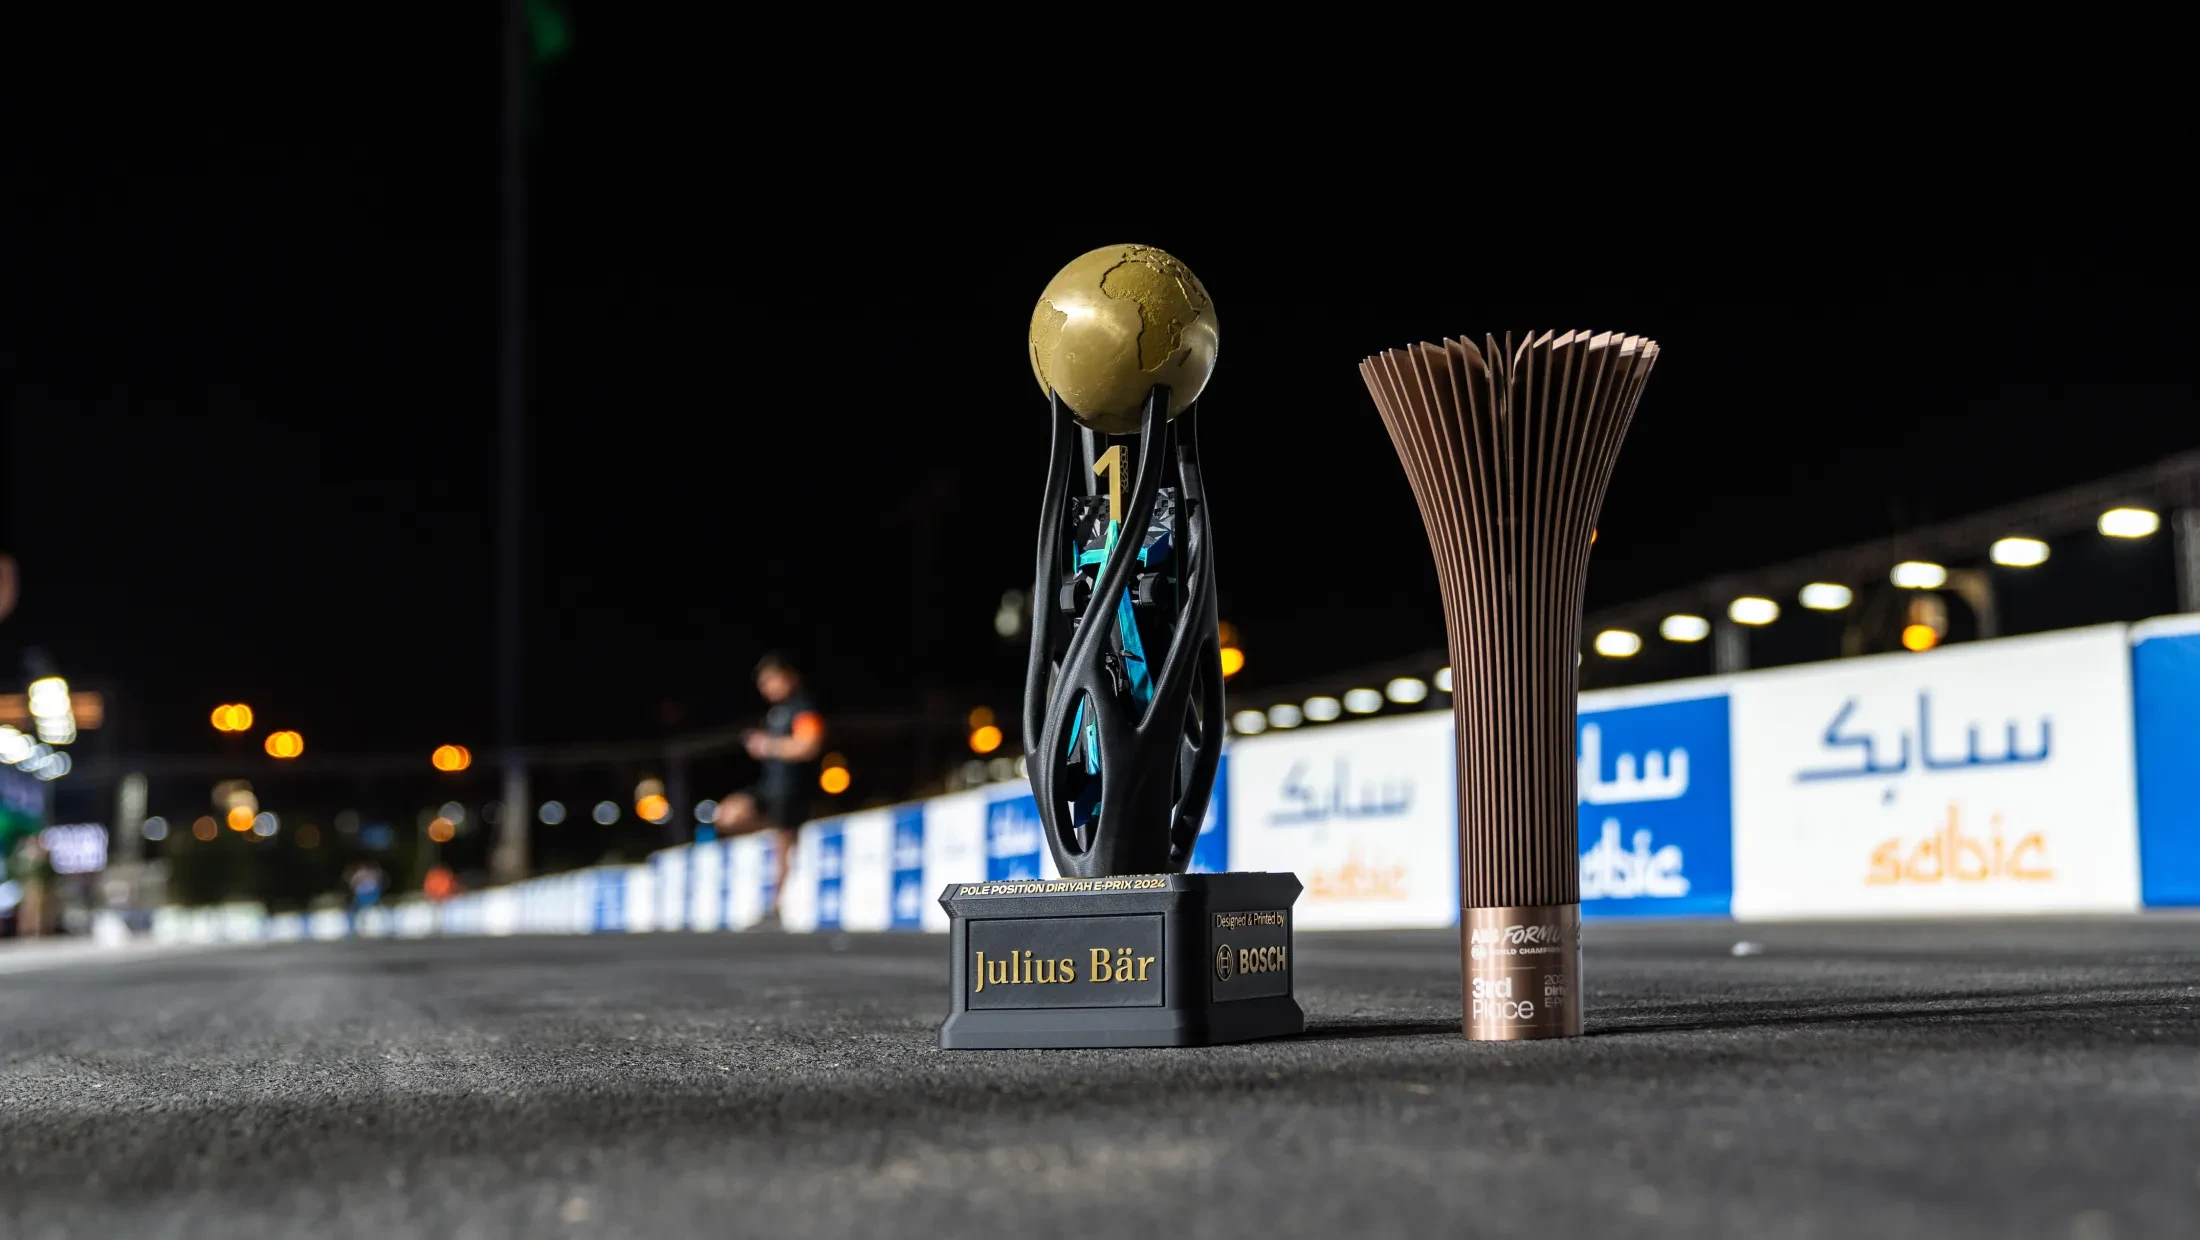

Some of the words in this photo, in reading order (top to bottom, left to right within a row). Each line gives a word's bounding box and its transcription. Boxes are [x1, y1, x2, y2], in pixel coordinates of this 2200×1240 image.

[1865, 801, 2053, 885] sabic
[960, 885, 991, 896] POLE
[991, 883, 1046, 894] POSITION
[1046, 881, 1092, 892] DIRIYAH
[1093, 880, 1132, 891] E-PRIX
[1133, 878, 1166, 889] 2024
[1216, 914, 1246, 929] Designed
[1247, 913, 1253, 926] &
[1253, 912, 1276, 926] Printed
[1276, 911, 1285, 928] by
[975, 949, 1076, 993] Julius
[1089, 947, 1156, 984] Bär
[1240, 946, 1286, 974] BOSCH
[1472, 977, 1512, 999] 3rd
[1473, 1000, 1534, 1020] Place
